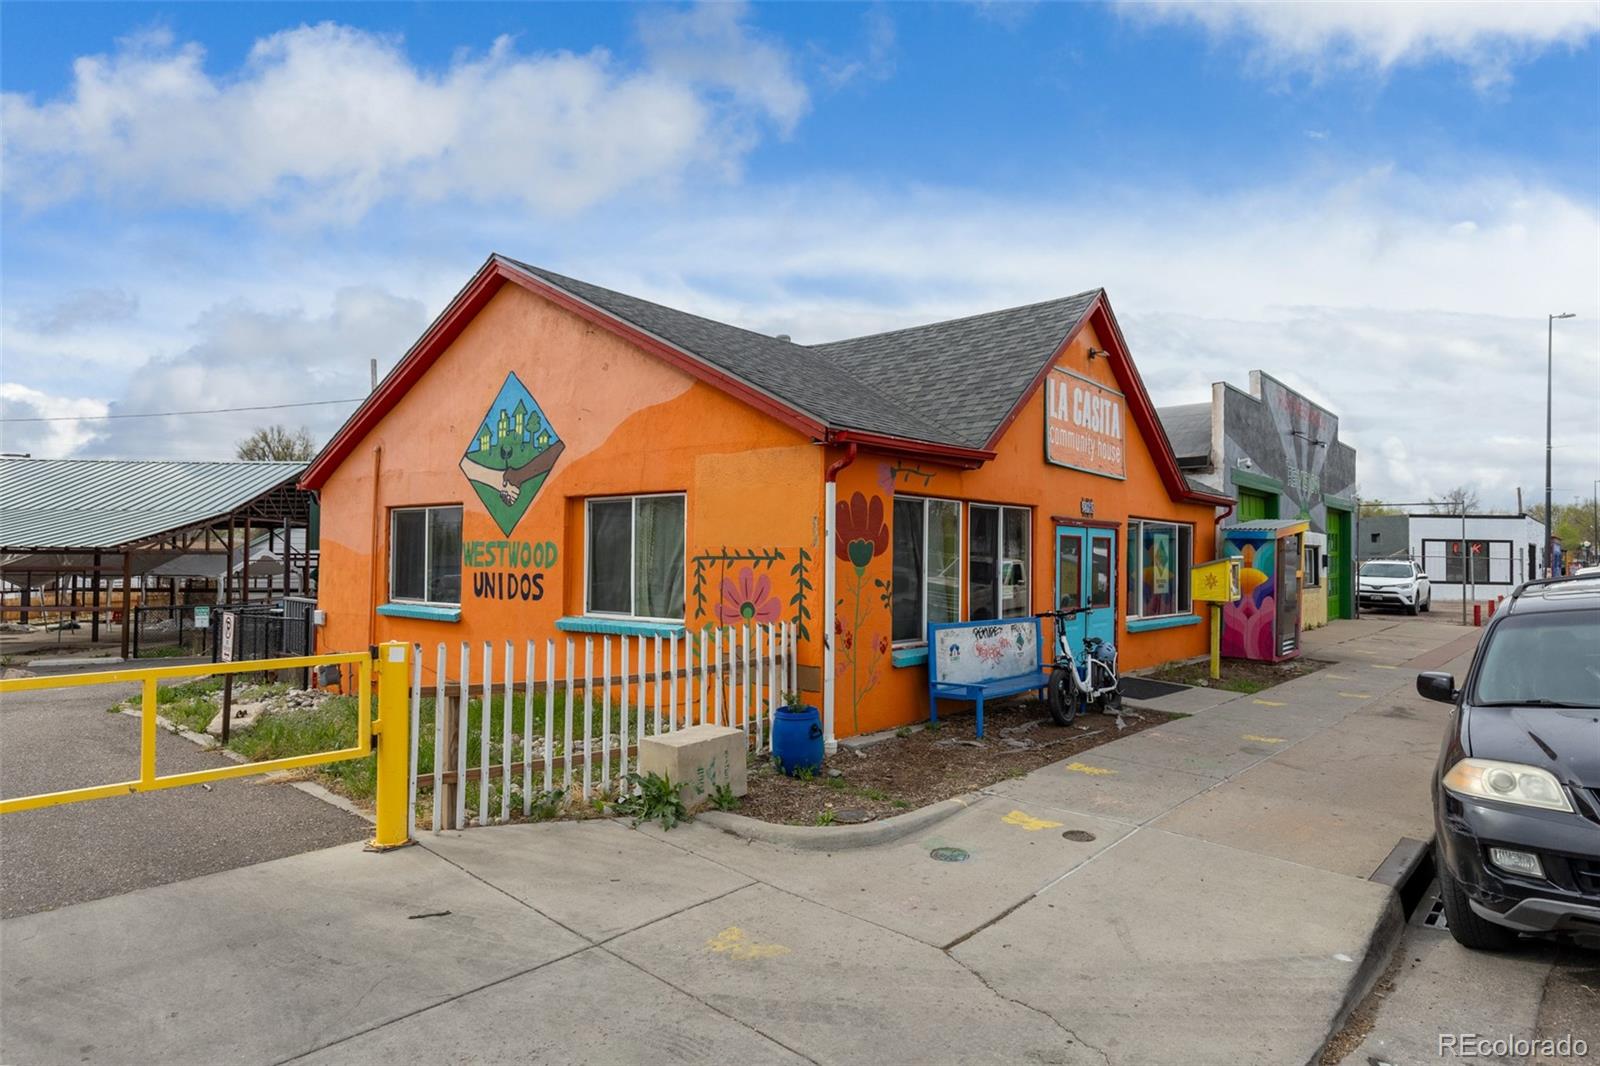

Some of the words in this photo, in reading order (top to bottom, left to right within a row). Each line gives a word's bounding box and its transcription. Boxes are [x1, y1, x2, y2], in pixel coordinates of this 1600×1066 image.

[1048, 378, 1069, 422] LA
[1073, 387, 1120, 439] CASITA
[1049, 425, 1096, 462] community
[463, 540, 558, 568] WESTWOOD
[474, 572, 544, 601] UNIDOS
